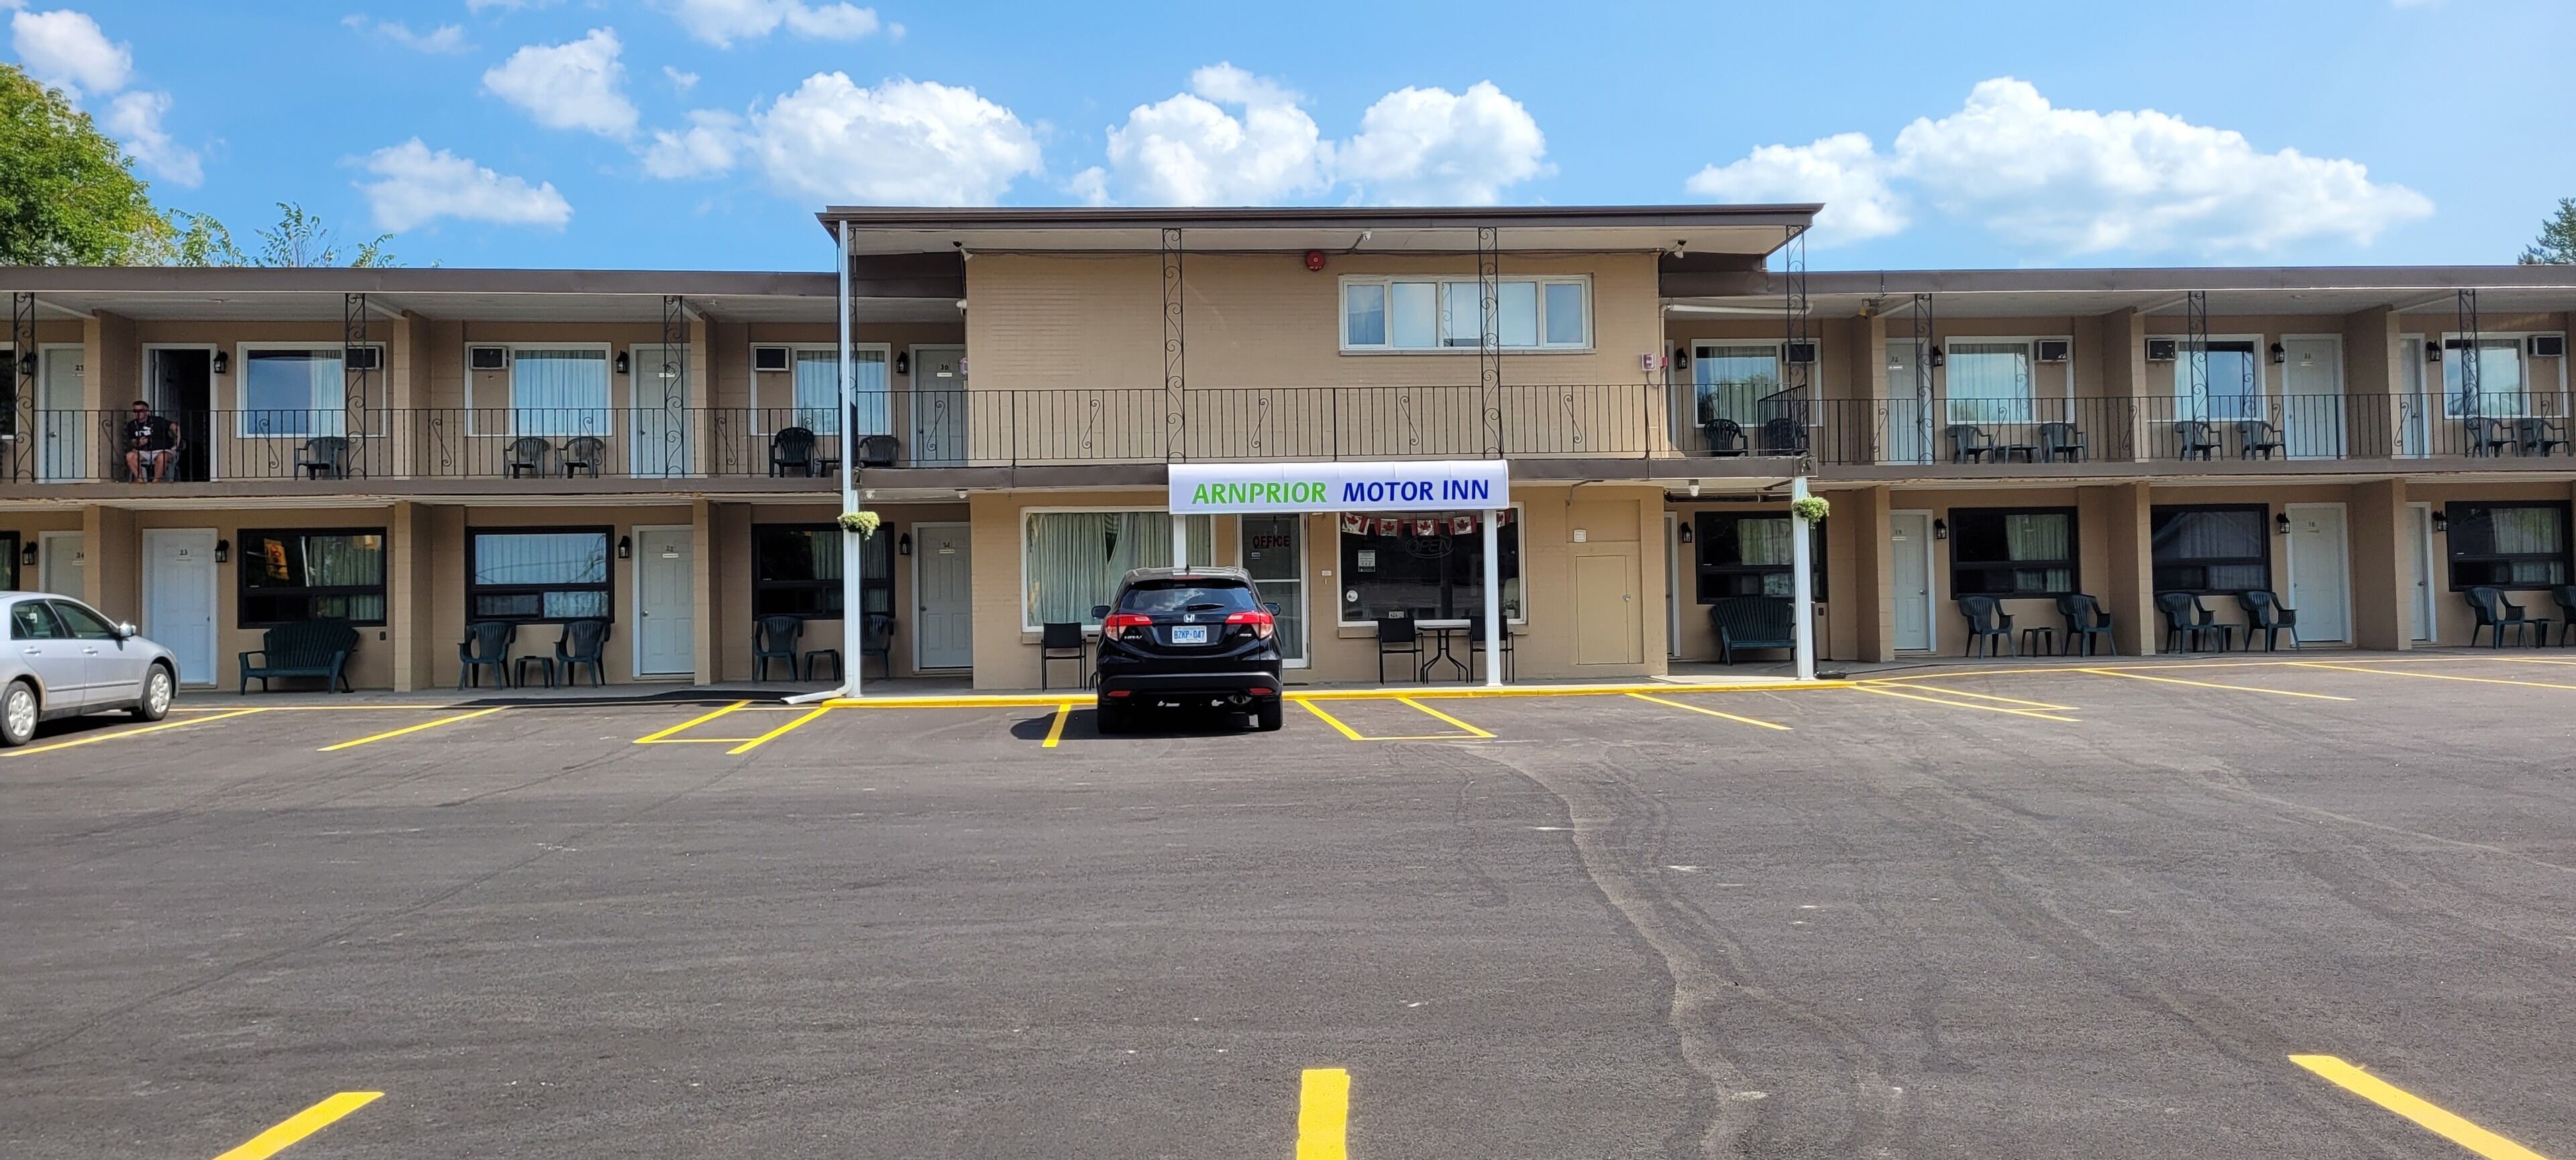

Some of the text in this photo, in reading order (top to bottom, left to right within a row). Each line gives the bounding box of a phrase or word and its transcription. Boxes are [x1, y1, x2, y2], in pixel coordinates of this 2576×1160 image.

[1192, 479, 1489, 505] ARNPRIOR MOTOR INN
[1252, 535, 1290, 547] OFFICE
[1409, 539, 1452, 553] OPEN
